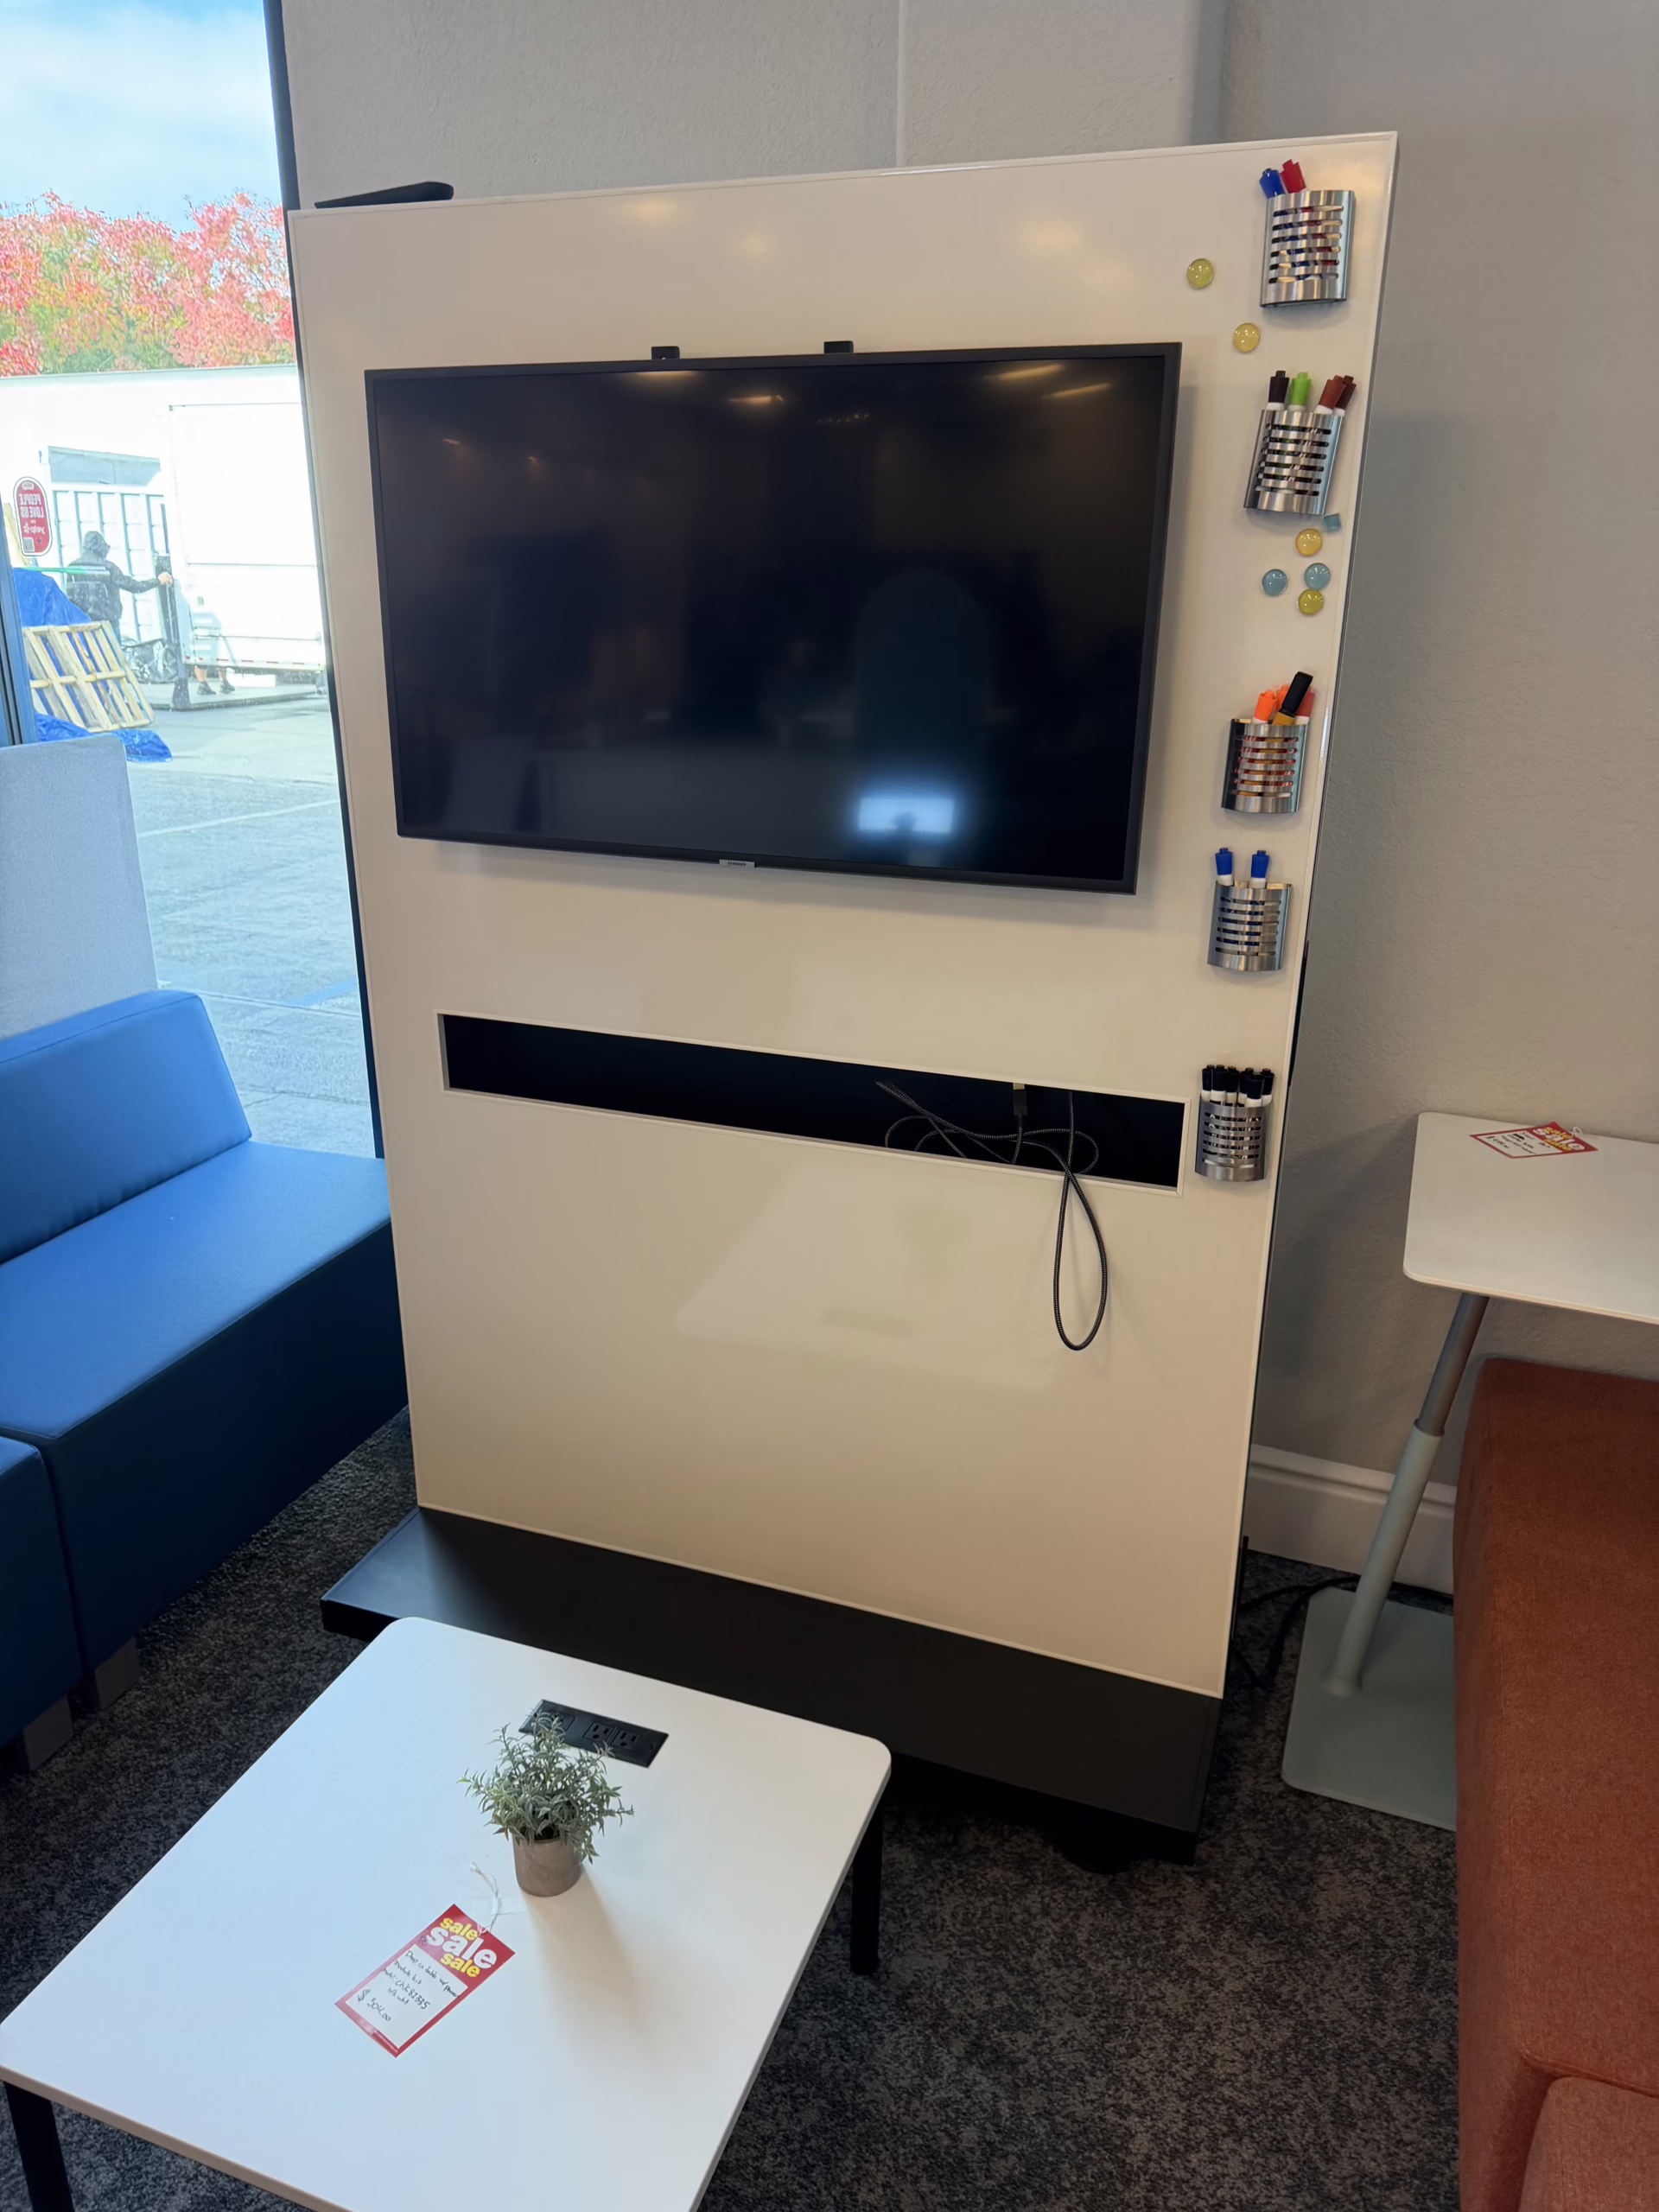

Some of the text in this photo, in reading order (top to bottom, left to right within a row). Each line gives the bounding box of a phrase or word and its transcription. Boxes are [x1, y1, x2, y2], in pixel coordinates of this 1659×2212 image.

[1533, 1128, 1585, 1150] sale
[440, 1917, 479, 1941] sale
[426, 1927, 497, 1969] sale
[440, 1953, 480, 1978] sale
